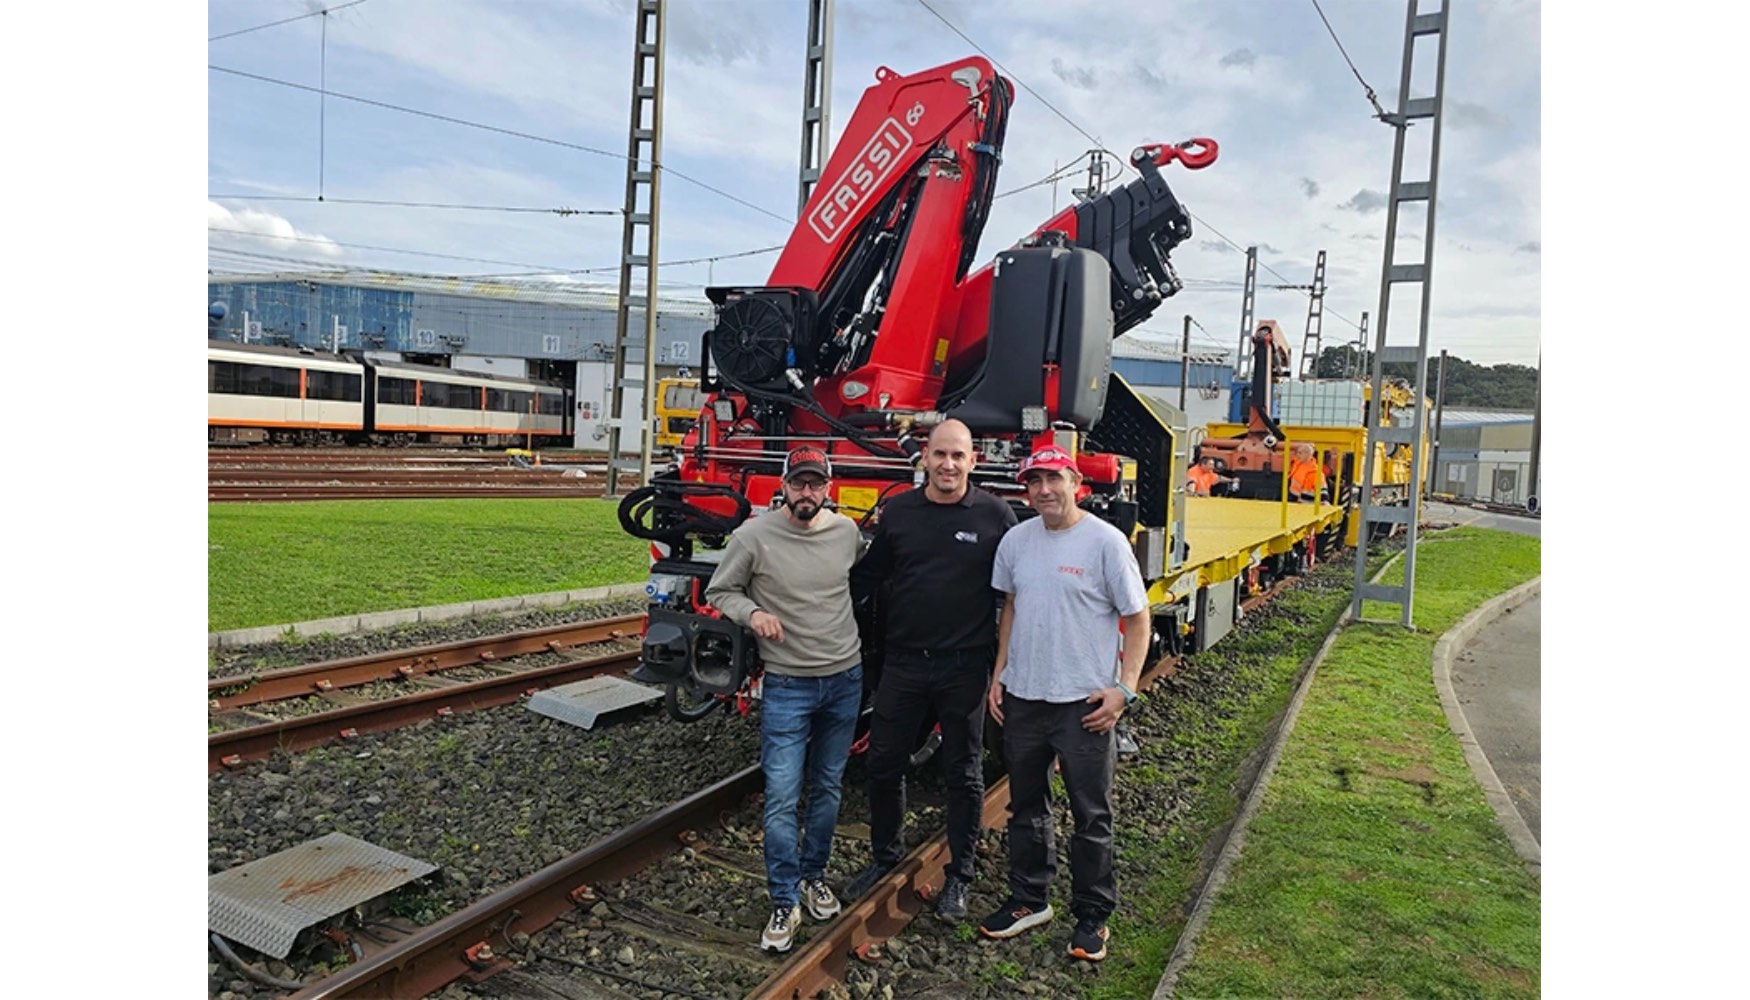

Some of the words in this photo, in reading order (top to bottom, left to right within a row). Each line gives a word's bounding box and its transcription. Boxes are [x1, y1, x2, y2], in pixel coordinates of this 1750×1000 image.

[820, 131, 900, 229] FASSI
[419, 331, 432, 345] 10
[546, 336, 557, 351] 11
[674, 343, 687, 358] 12
